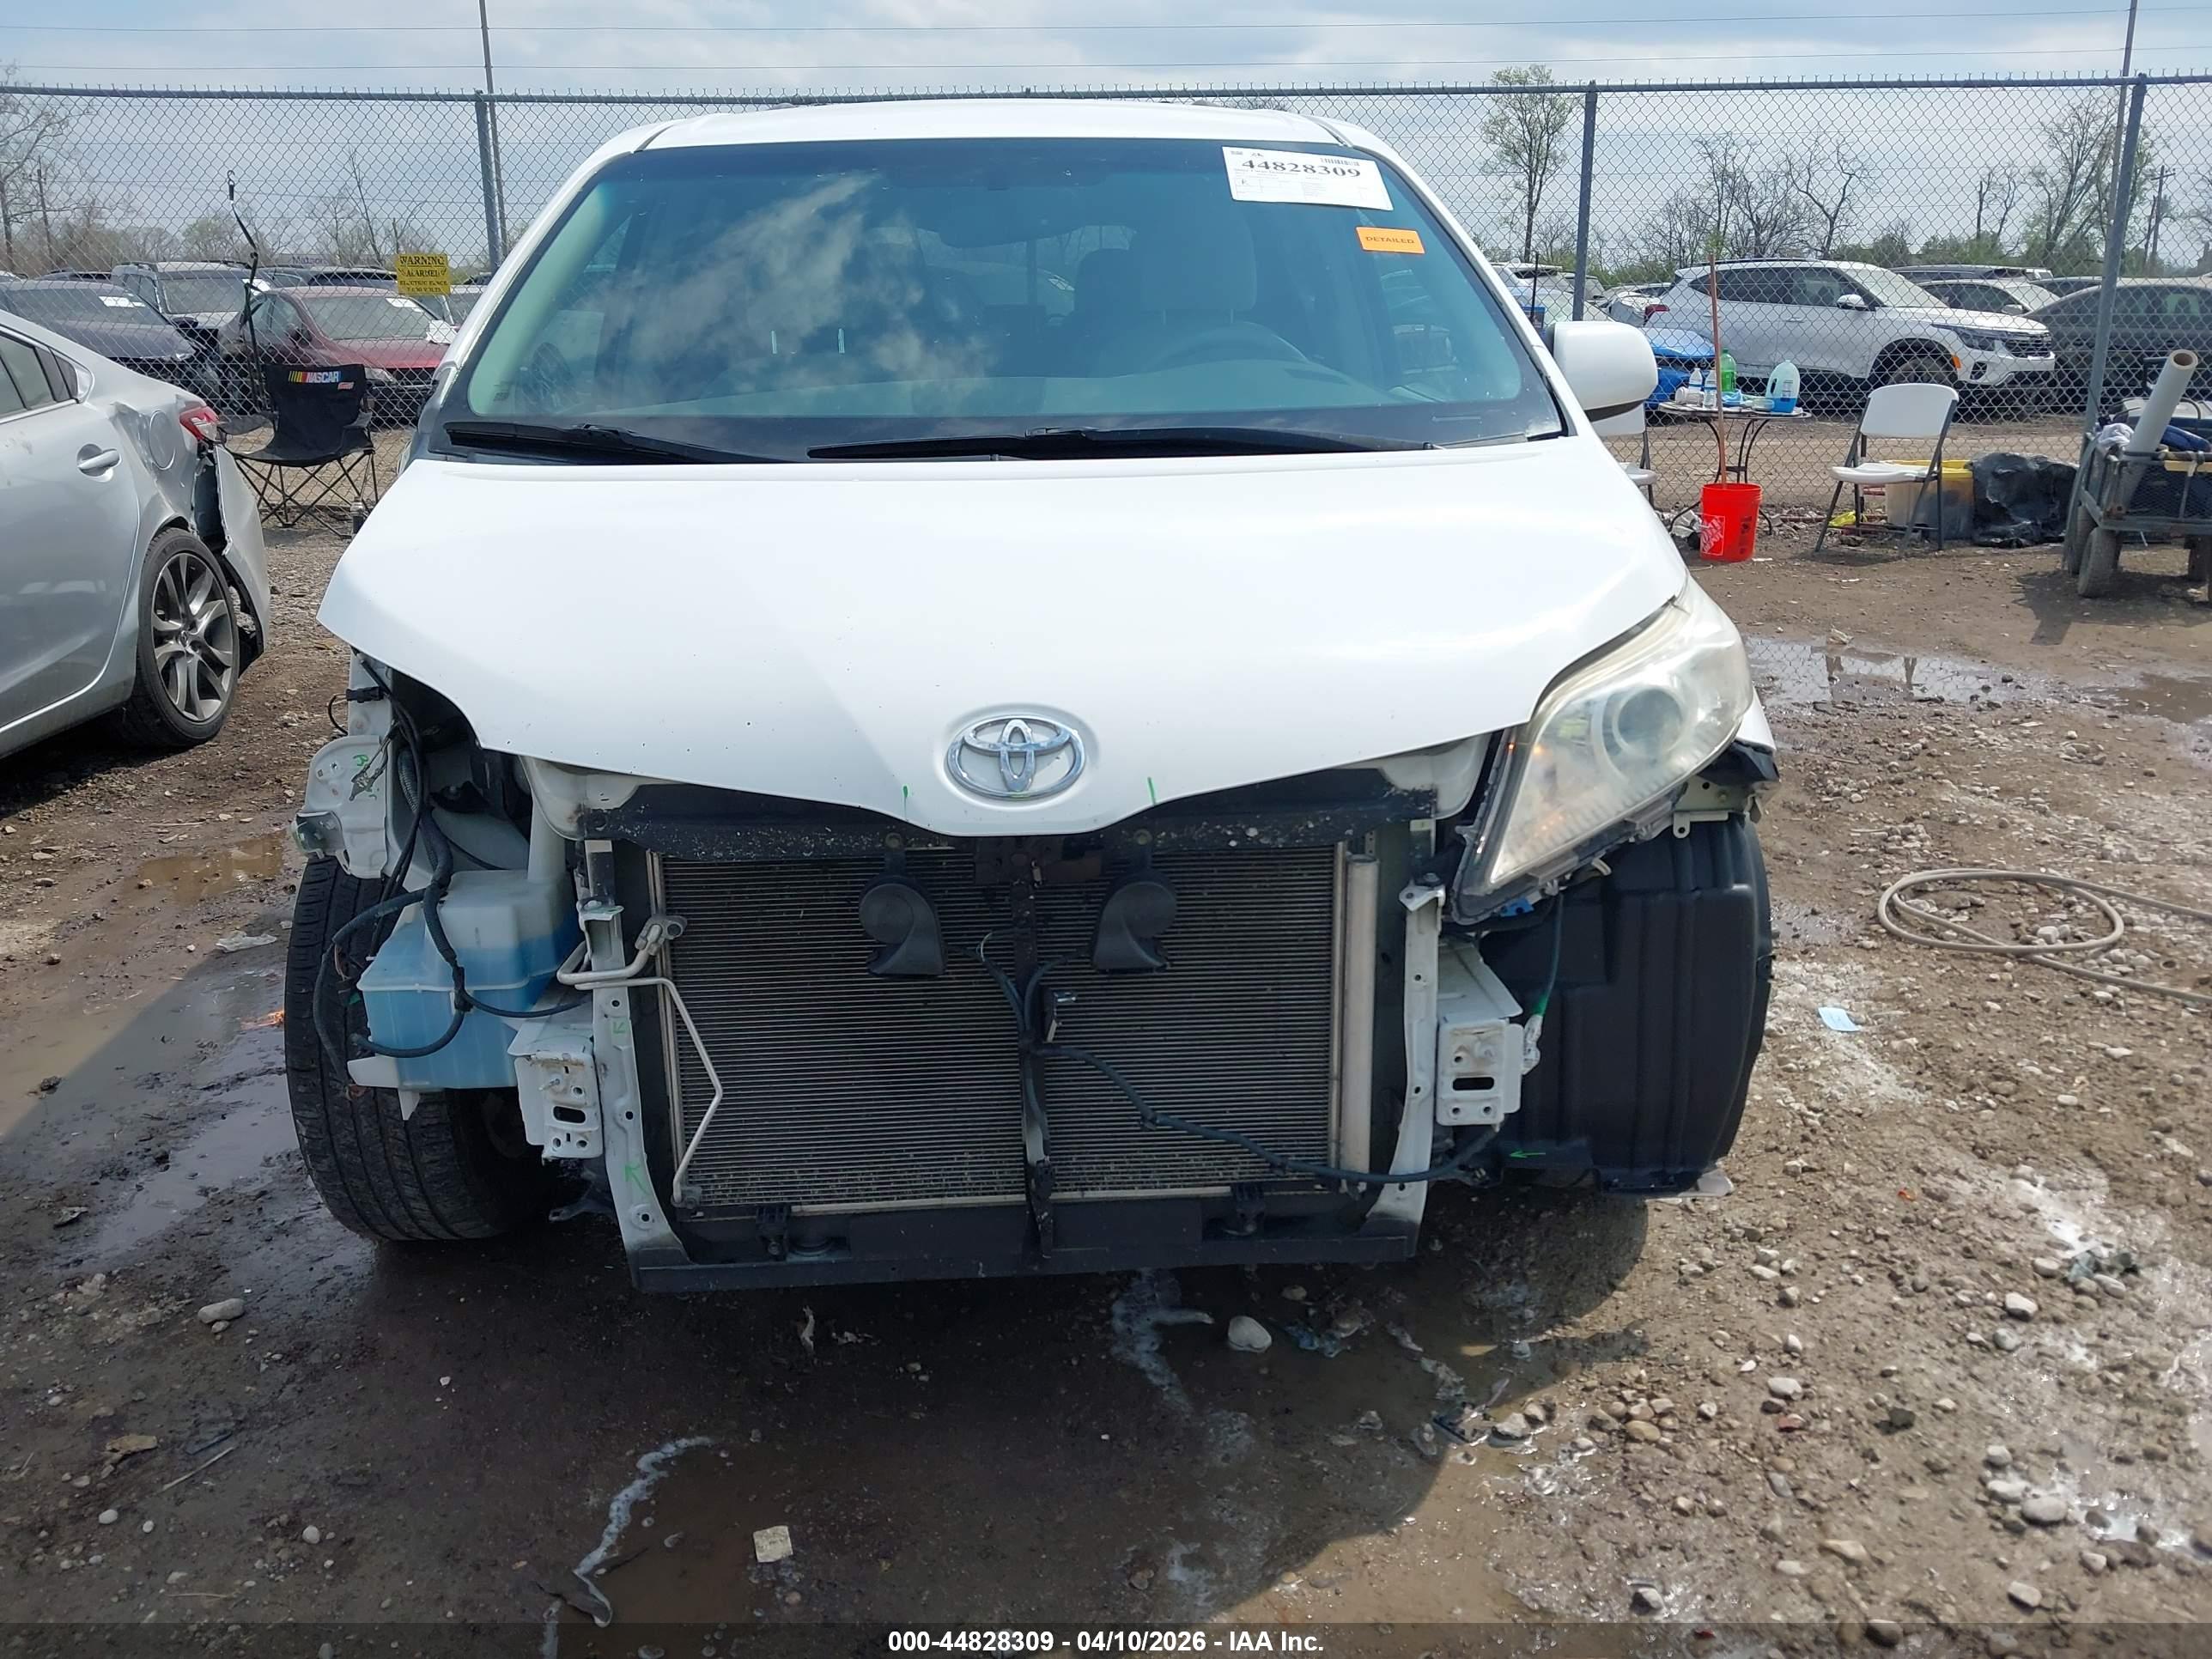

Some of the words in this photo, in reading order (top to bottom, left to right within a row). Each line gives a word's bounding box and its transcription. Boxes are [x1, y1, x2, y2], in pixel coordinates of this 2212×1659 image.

[1242, 160, 1361, 178] 44828309
[399, 255, 445, 265] WARNING
[306, 371, 339, 383] NASCAR
